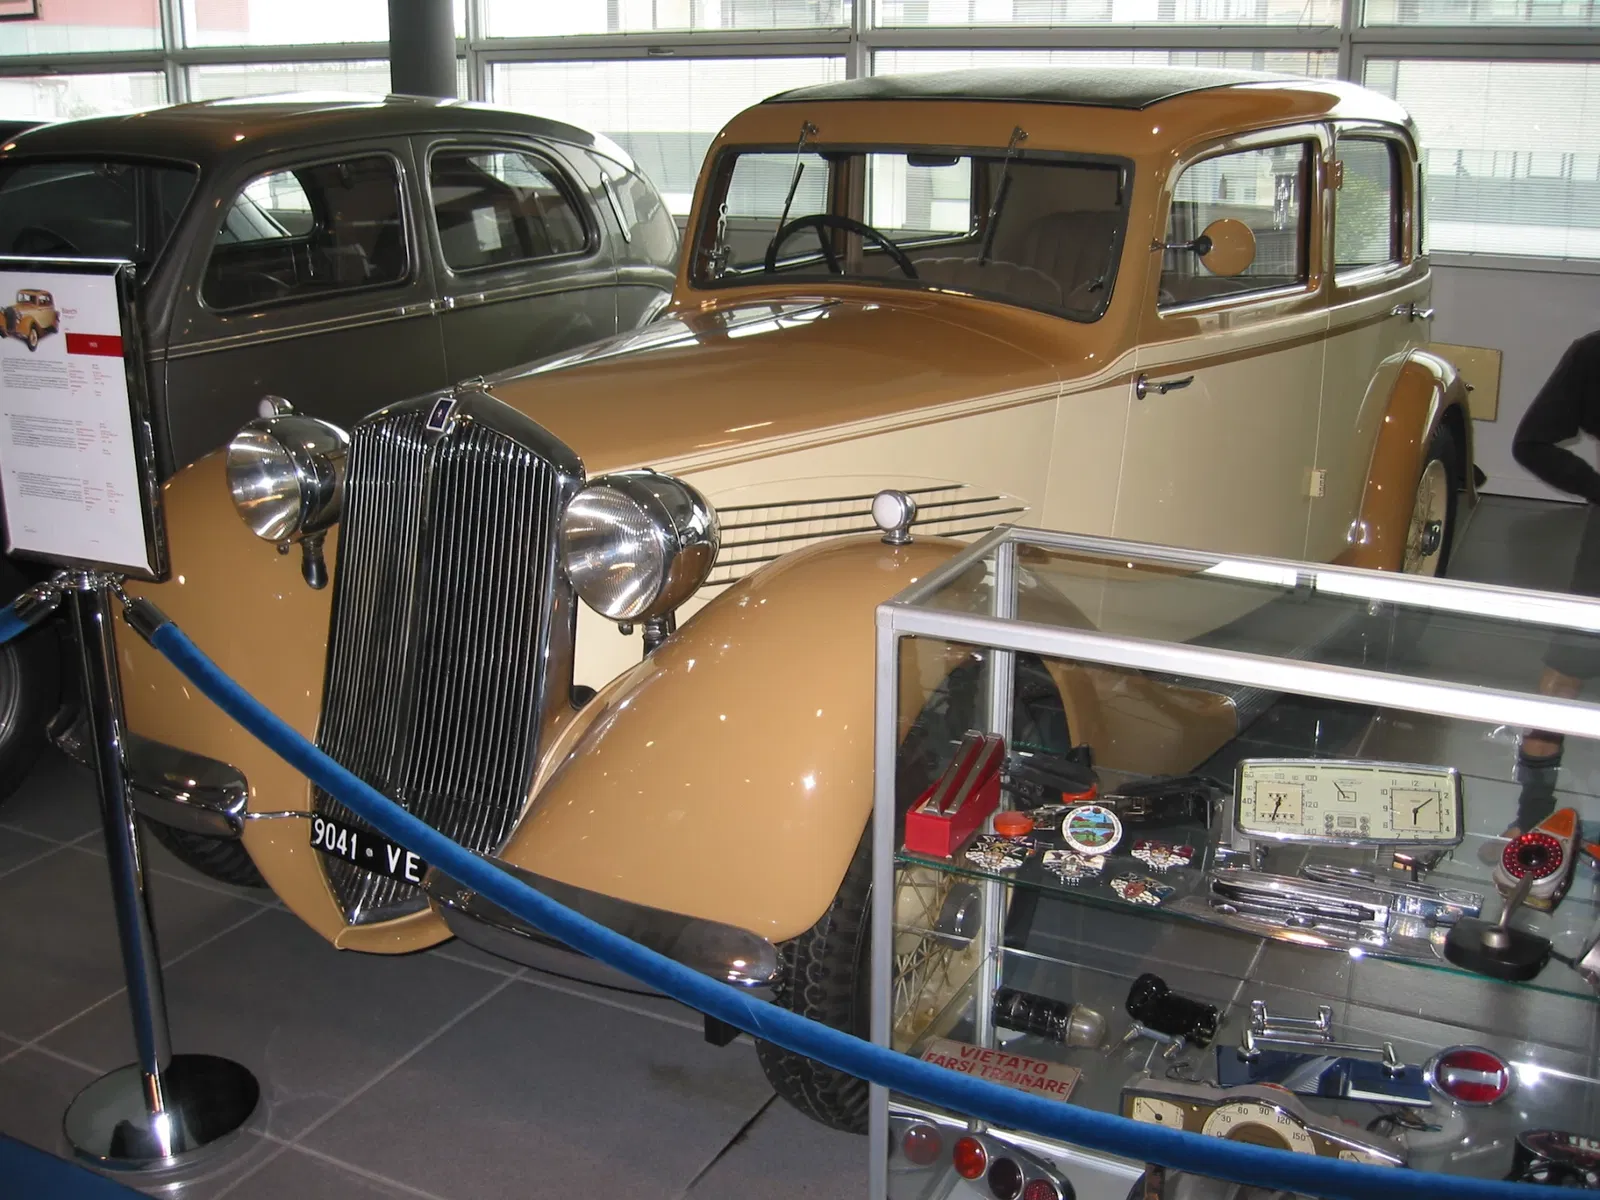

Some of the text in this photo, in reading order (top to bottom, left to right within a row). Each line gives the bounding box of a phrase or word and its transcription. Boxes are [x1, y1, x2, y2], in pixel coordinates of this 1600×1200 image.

[1380, 788, 1388, 796] 10
[314, 818, 421, 882] 9041 VE
[960, 1046, 1048, 1075] VIETATO
[925, 1053, 1069, 1094] FARSI TRAINARE
[1259, 1107, 1270, 1115] 90
[1221, 1115, 1231, 1123] 30
[1277, 1116, 1291, 1125] 120
[1292, 1131, 1306, 1141] 150
